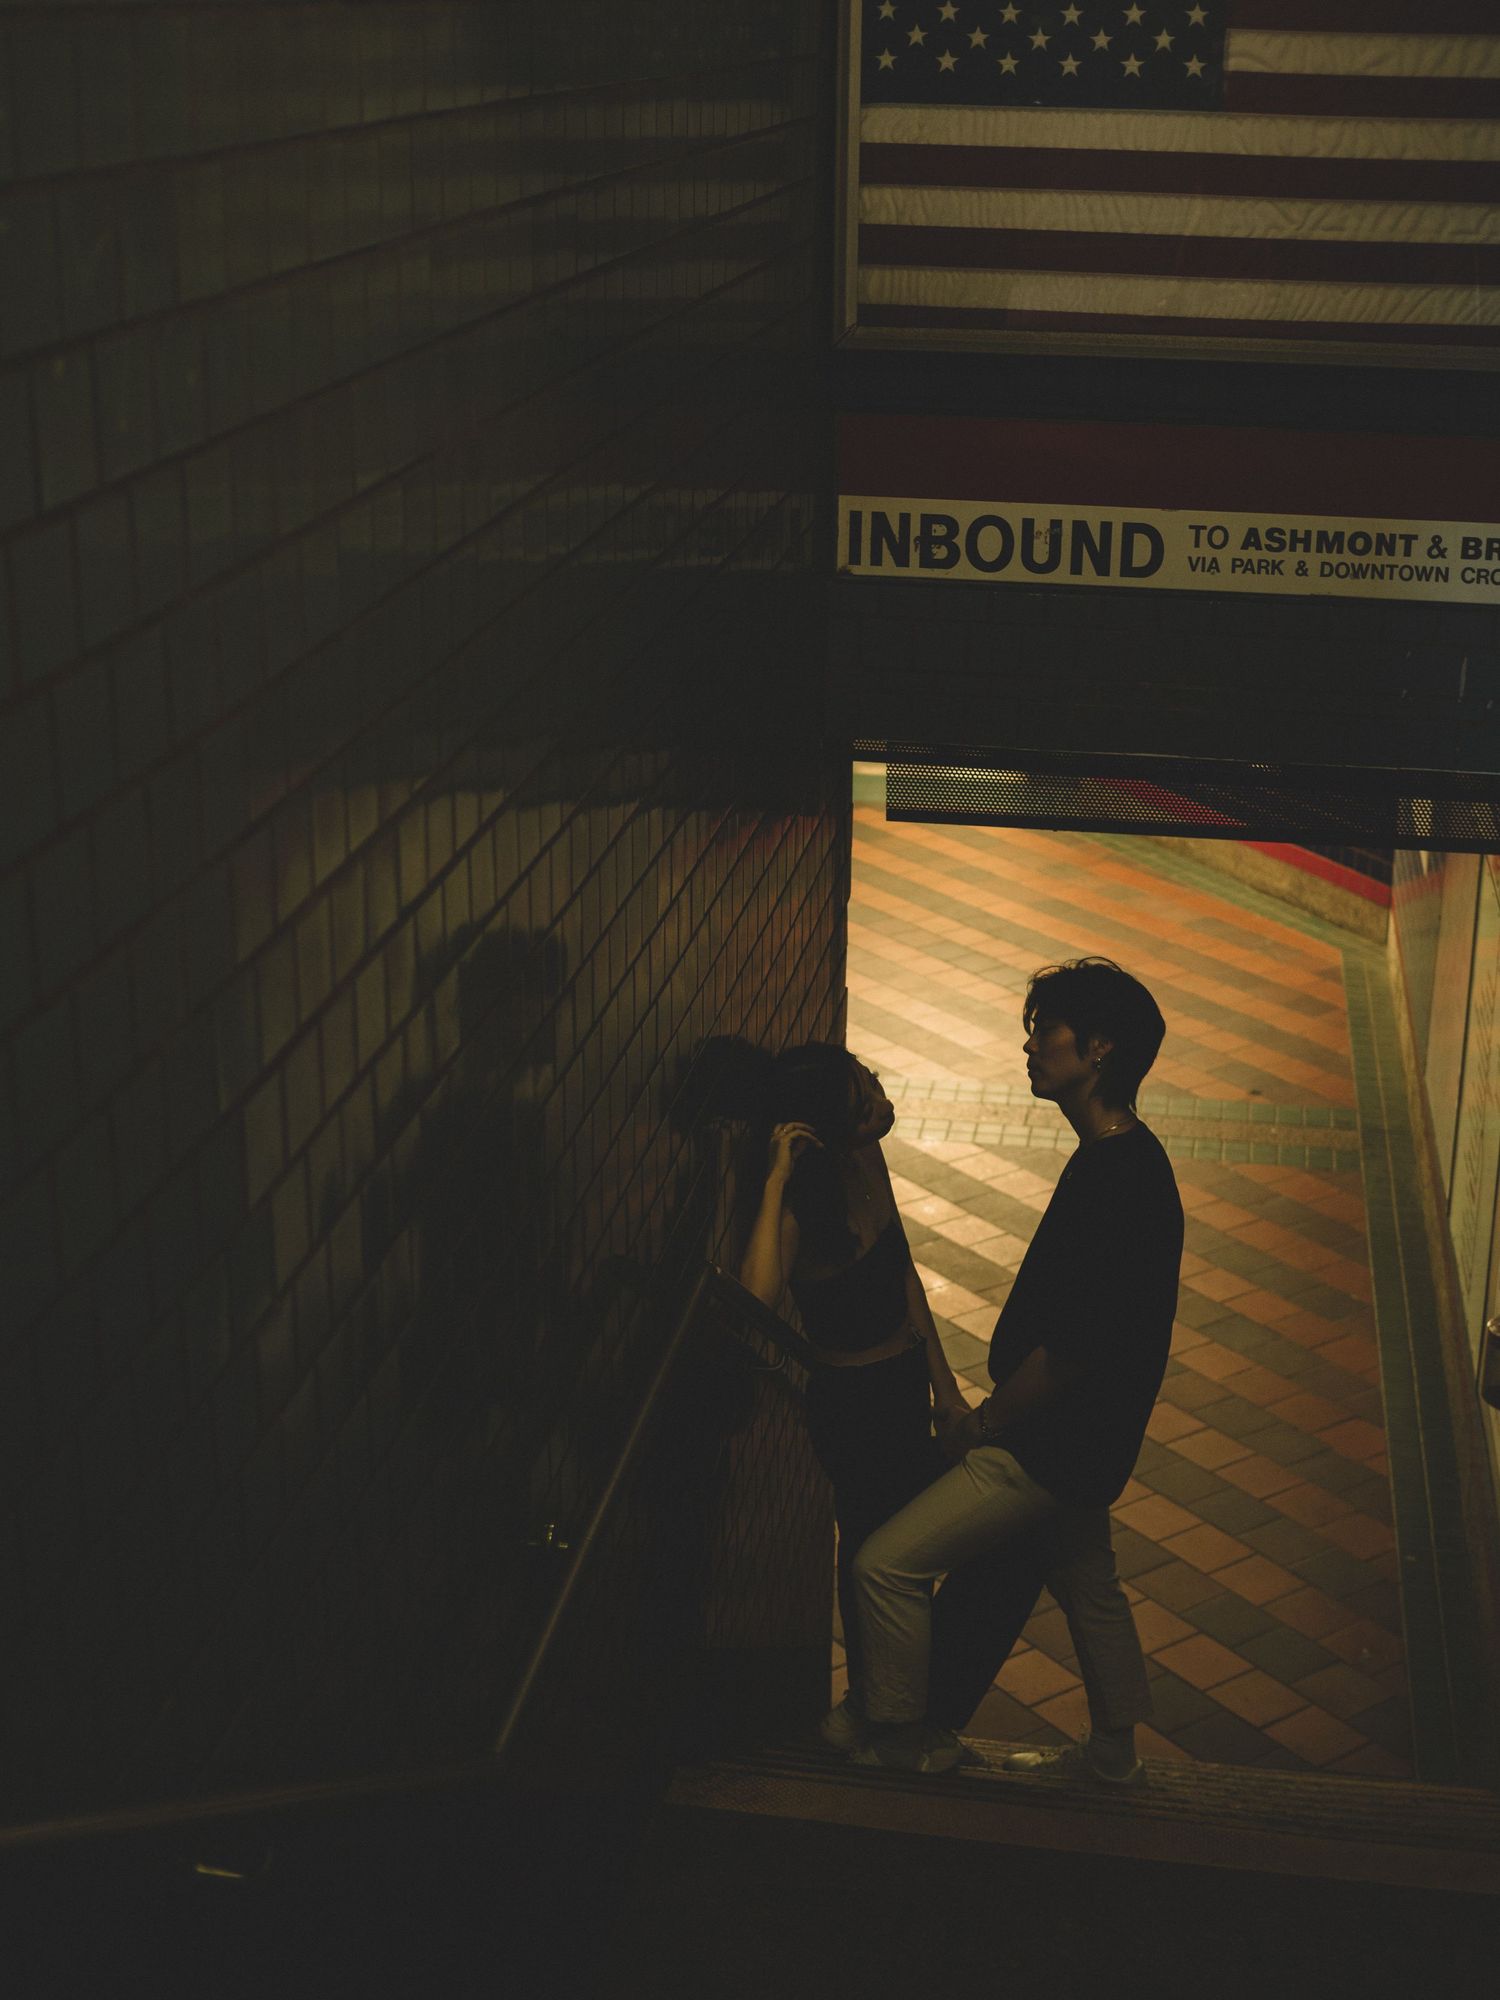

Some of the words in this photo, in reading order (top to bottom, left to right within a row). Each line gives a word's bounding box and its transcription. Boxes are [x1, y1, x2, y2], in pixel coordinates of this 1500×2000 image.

[848, 510, 1165, 580] INBOUND
[1188, 524, 1230, 550] TO
[1239, 526, 1419, 558] ASHMONT
[1426, 534, 1449, 560] &
[1460, 536, 1500, 562] BR
[1187, 555, 1221, 574] VIA
[1230, 557, 1286, 577] PARK
[1294, 559, 1310, 578] &
[1319, 560, 1450, 584] DOWNTOWN
[1460, 566, 1500, 586] CRO
